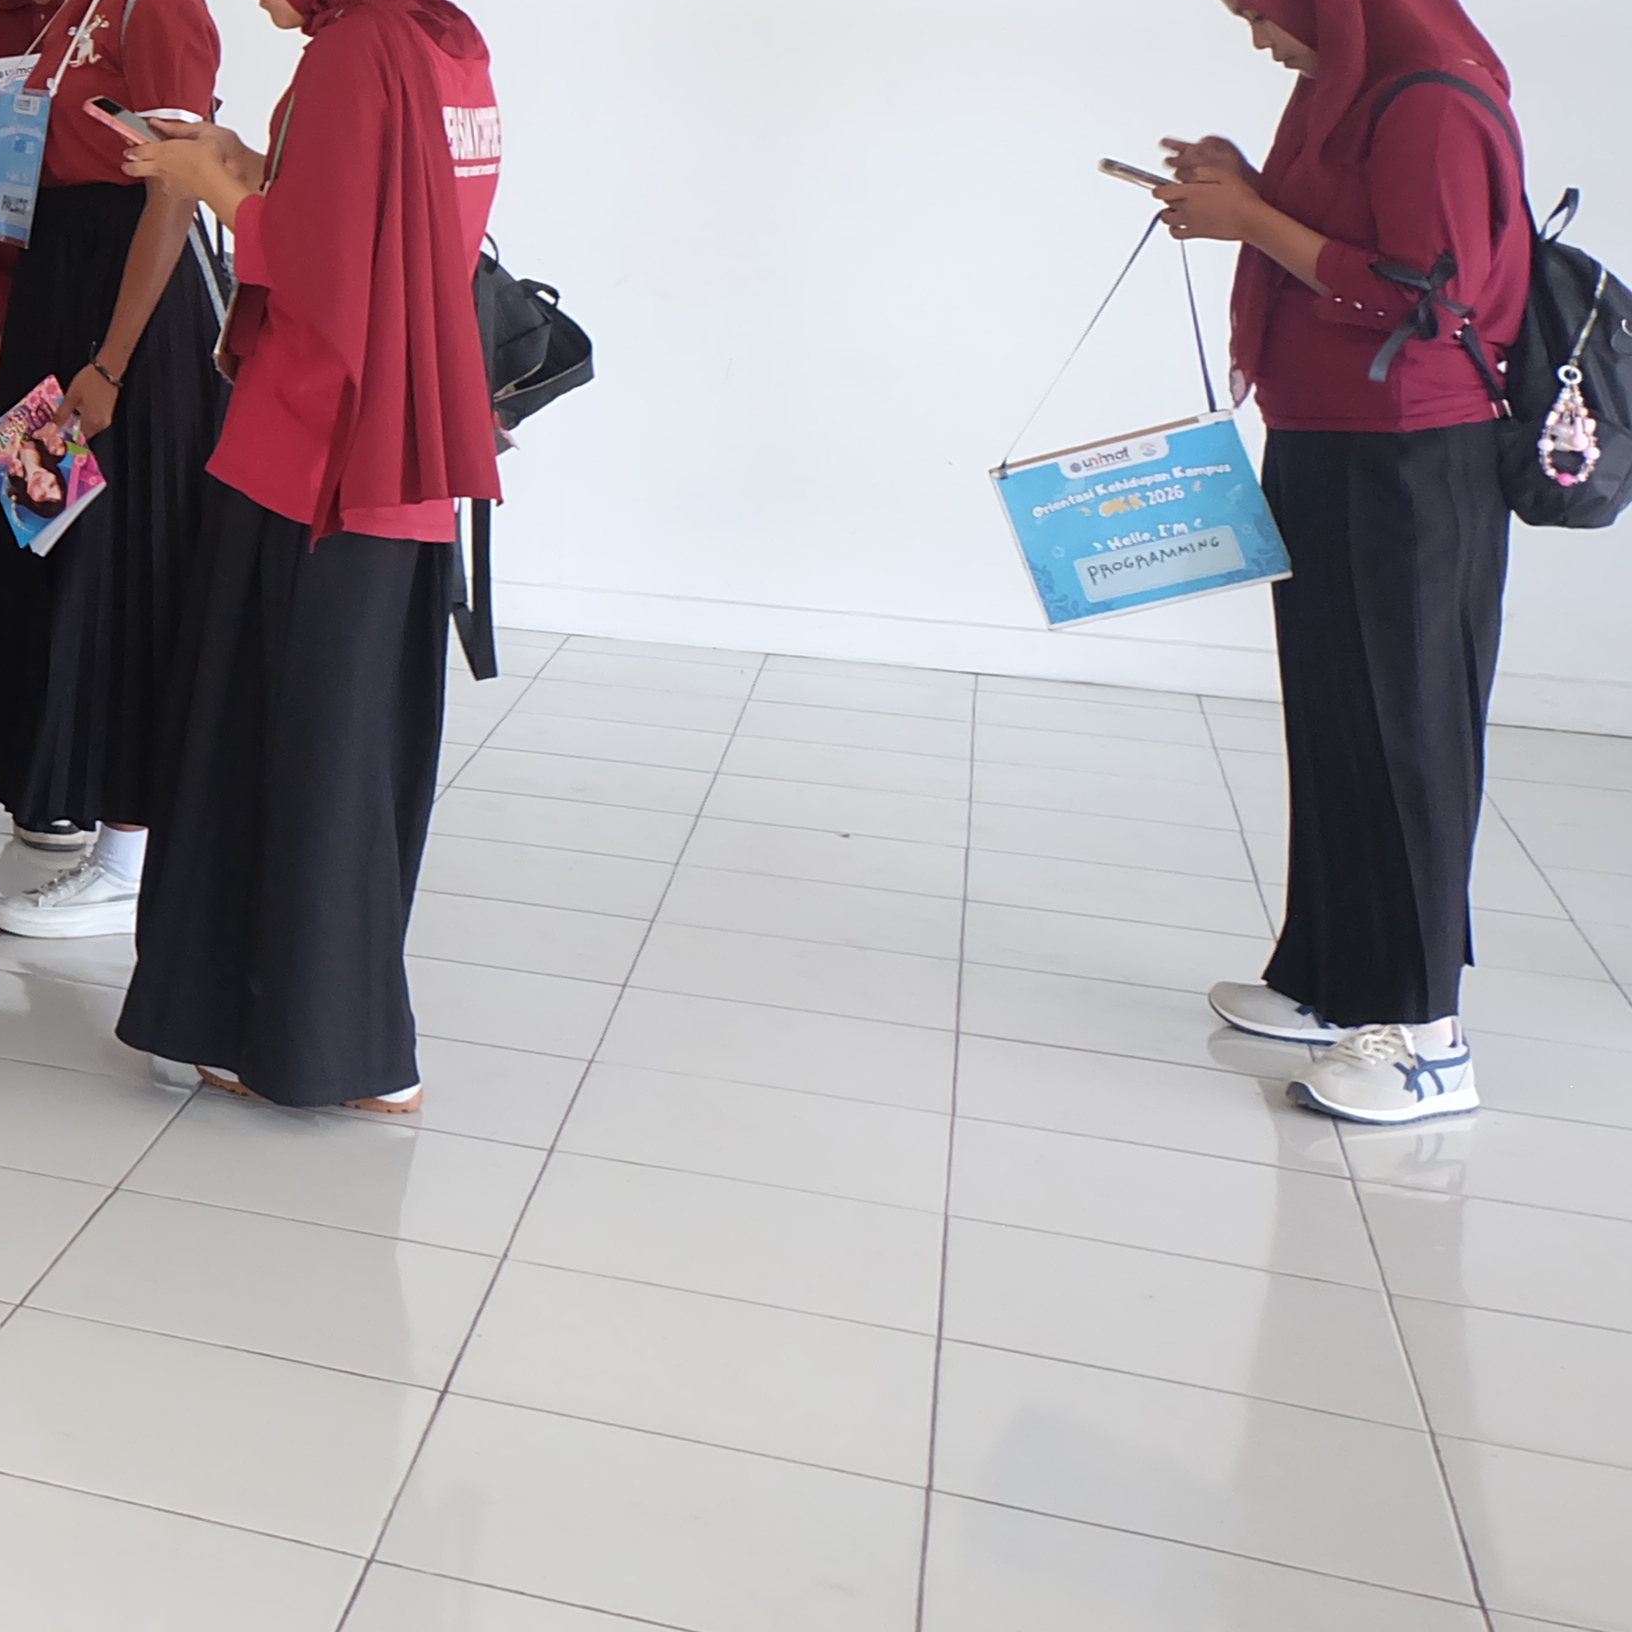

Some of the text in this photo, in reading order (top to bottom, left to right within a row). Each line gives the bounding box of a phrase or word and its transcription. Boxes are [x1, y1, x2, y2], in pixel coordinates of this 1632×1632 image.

[1032, 462, 1233, 518] Orientasi Kehidupan Kampus
[1087, 536, 1220, 585] PROGRAMMING
